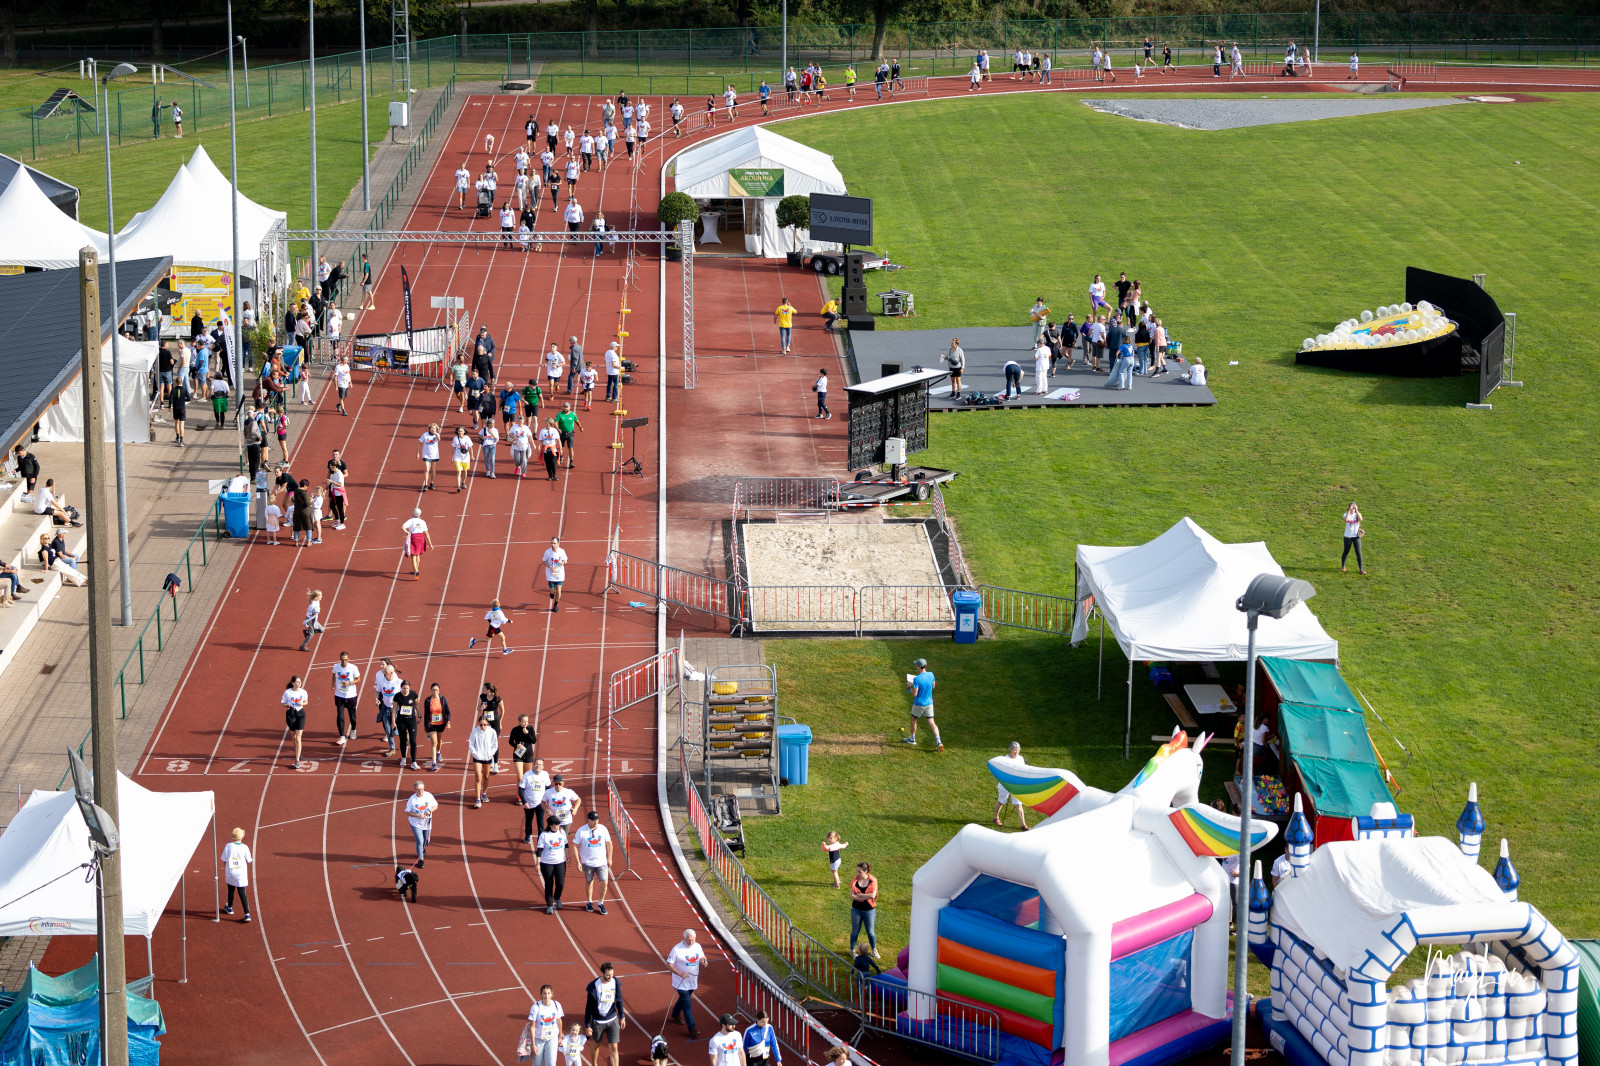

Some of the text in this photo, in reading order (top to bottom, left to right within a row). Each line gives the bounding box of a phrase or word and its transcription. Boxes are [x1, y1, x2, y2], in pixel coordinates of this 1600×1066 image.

[166, 760, 191, 772] 8
[228, 760, 251, 772] 7
[359, 760, 383, 773] 5
[551, 760, 574, 773] 2
[621, 760, 633, 773] 1
